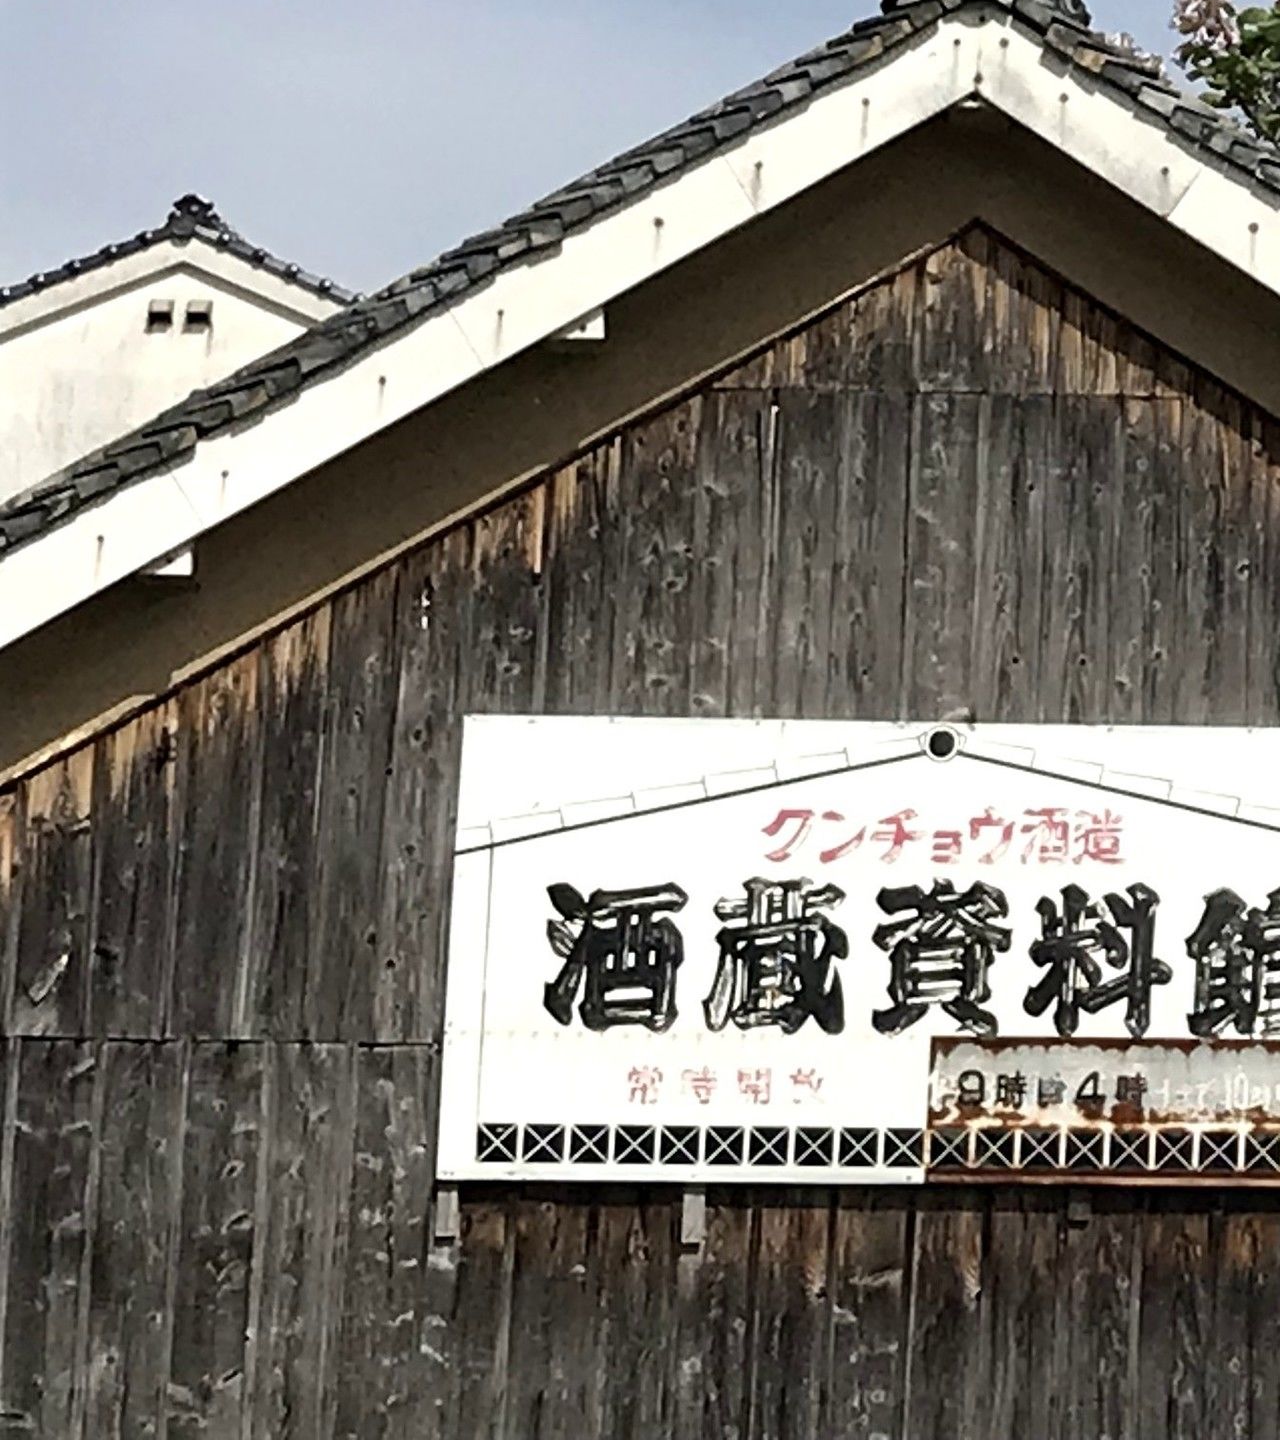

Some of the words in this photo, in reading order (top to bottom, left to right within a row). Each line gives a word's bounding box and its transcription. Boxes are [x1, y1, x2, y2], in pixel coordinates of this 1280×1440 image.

[761, 806, 1126, 864] クンチョウ酒造
